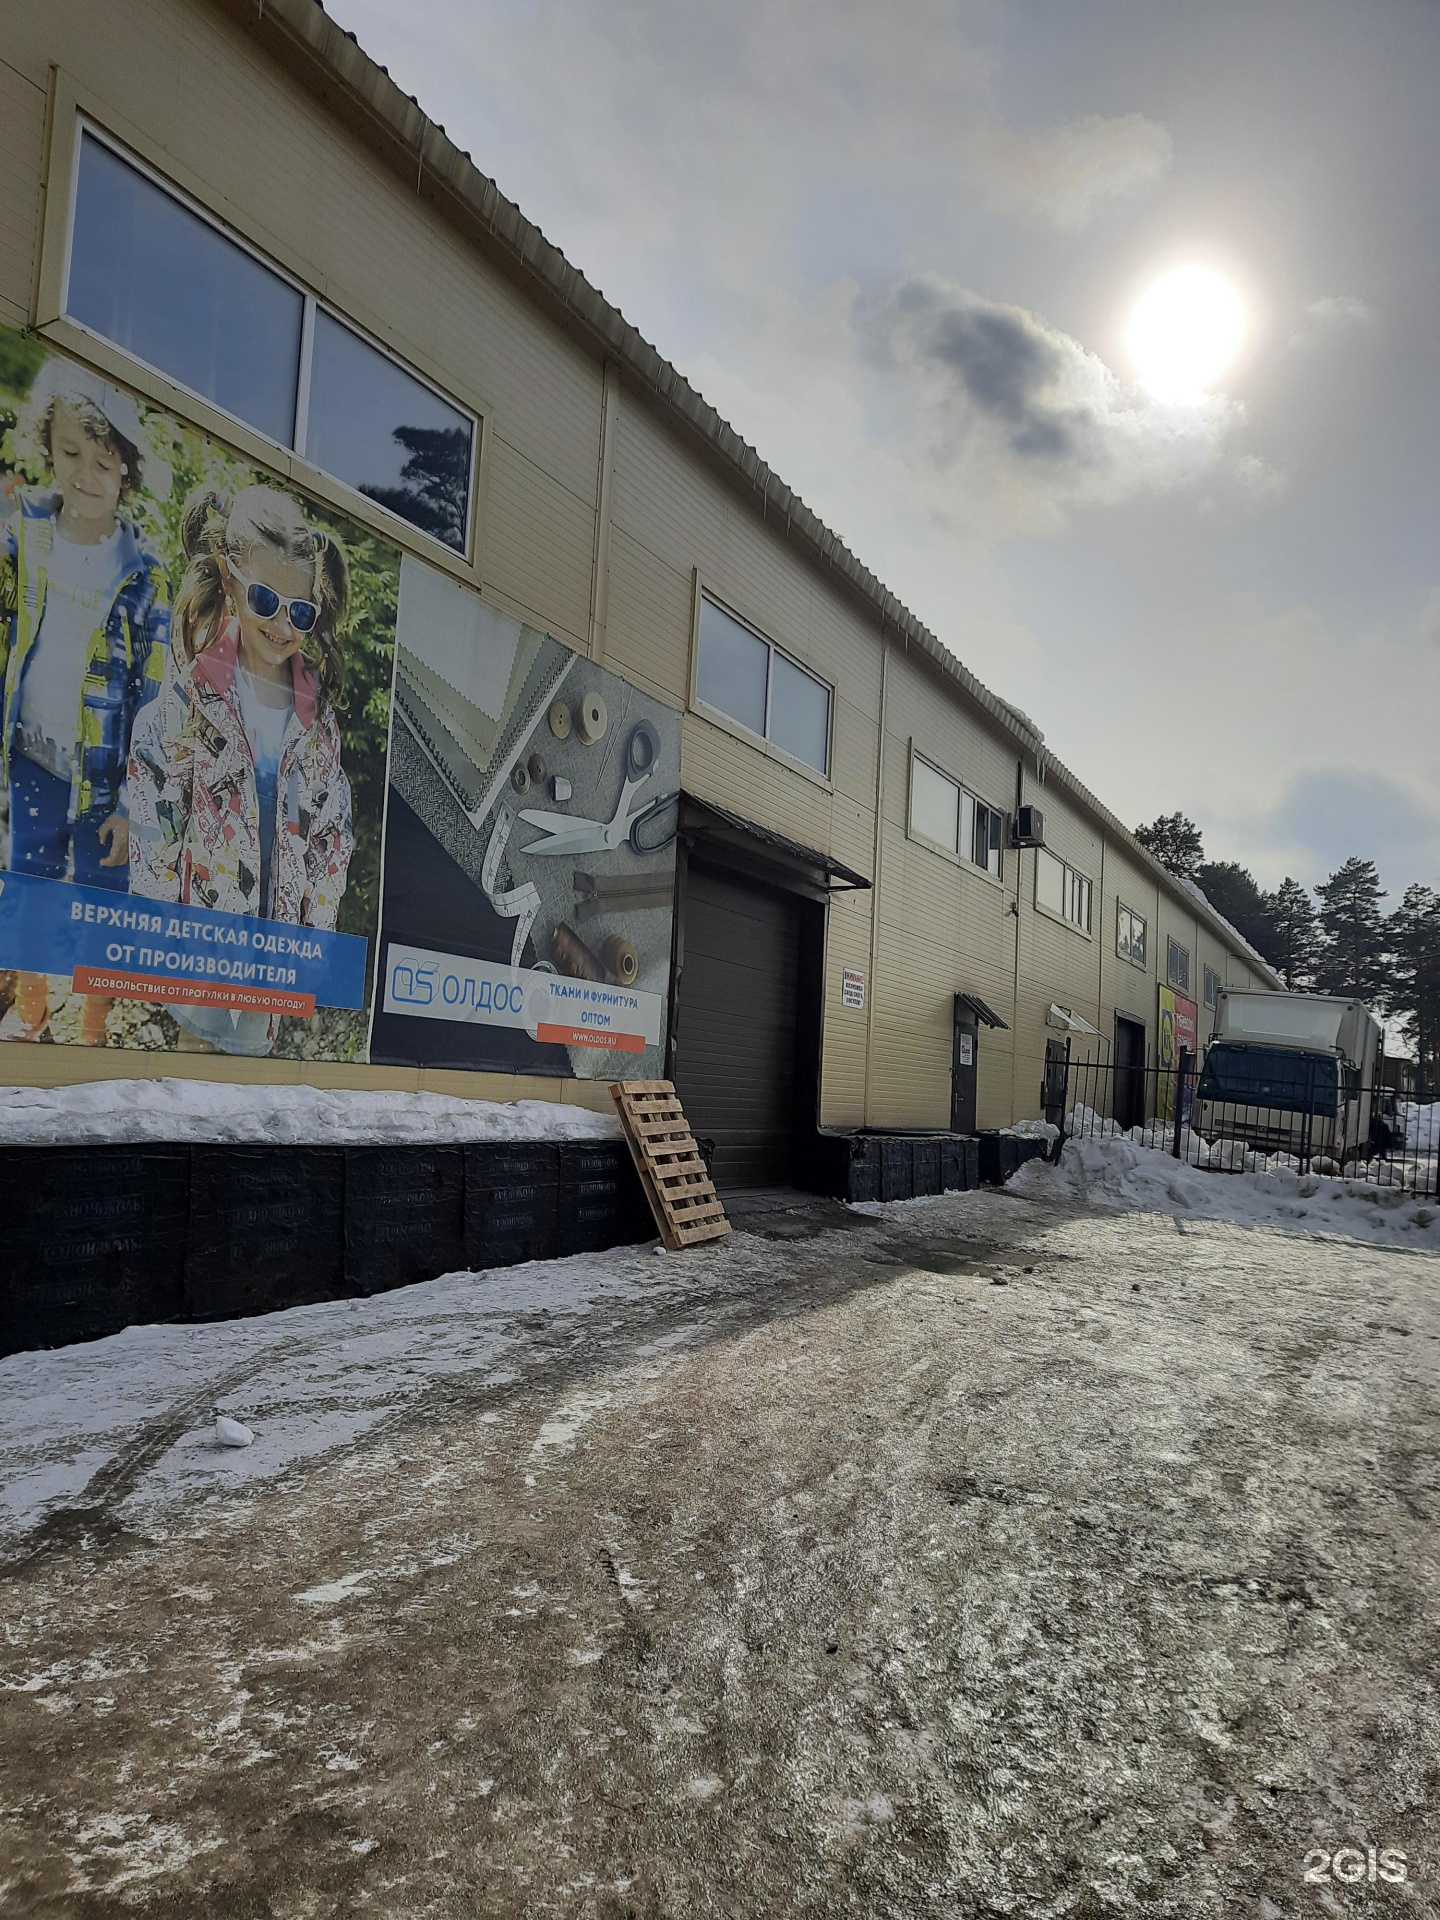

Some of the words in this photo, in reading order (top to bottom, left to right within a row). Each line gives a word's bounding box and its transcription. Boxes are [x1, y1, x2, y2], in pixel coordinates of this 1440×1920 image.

[71, 901, 162, 933] ВЕРХНЯЯ
[165, 918, 248, 947] ДЕТСКАЯ
[252, 932, 322, 960] ОДЕЖДА
[106, 943, 136, 963] ОТ
[139, 947, 297, 985] ПРОИЗВОДИТЕЛЯ
[88, 976, 166, 995] УДОВОЛЬСТВИЕ
[167, 986, 181, 996] ОТ
[182, 987, 230, 1001] ПРОГУЛКИ
[230, 993, 237, 1001] В
[238, 994, 271, 1006] ЛЮБУЮ
[272, 998, 306, 1009] ПОГОДУ!
[443, 975, 524, 1014] ОЛДОС
[550, 983, 582, 1000] ТКАНИ
[583, 990, 590, 1001] И
[590, 992, 639, 1009] ФУРНИТУРА
[581, 1011, 611, 1026] ОПТОМ
